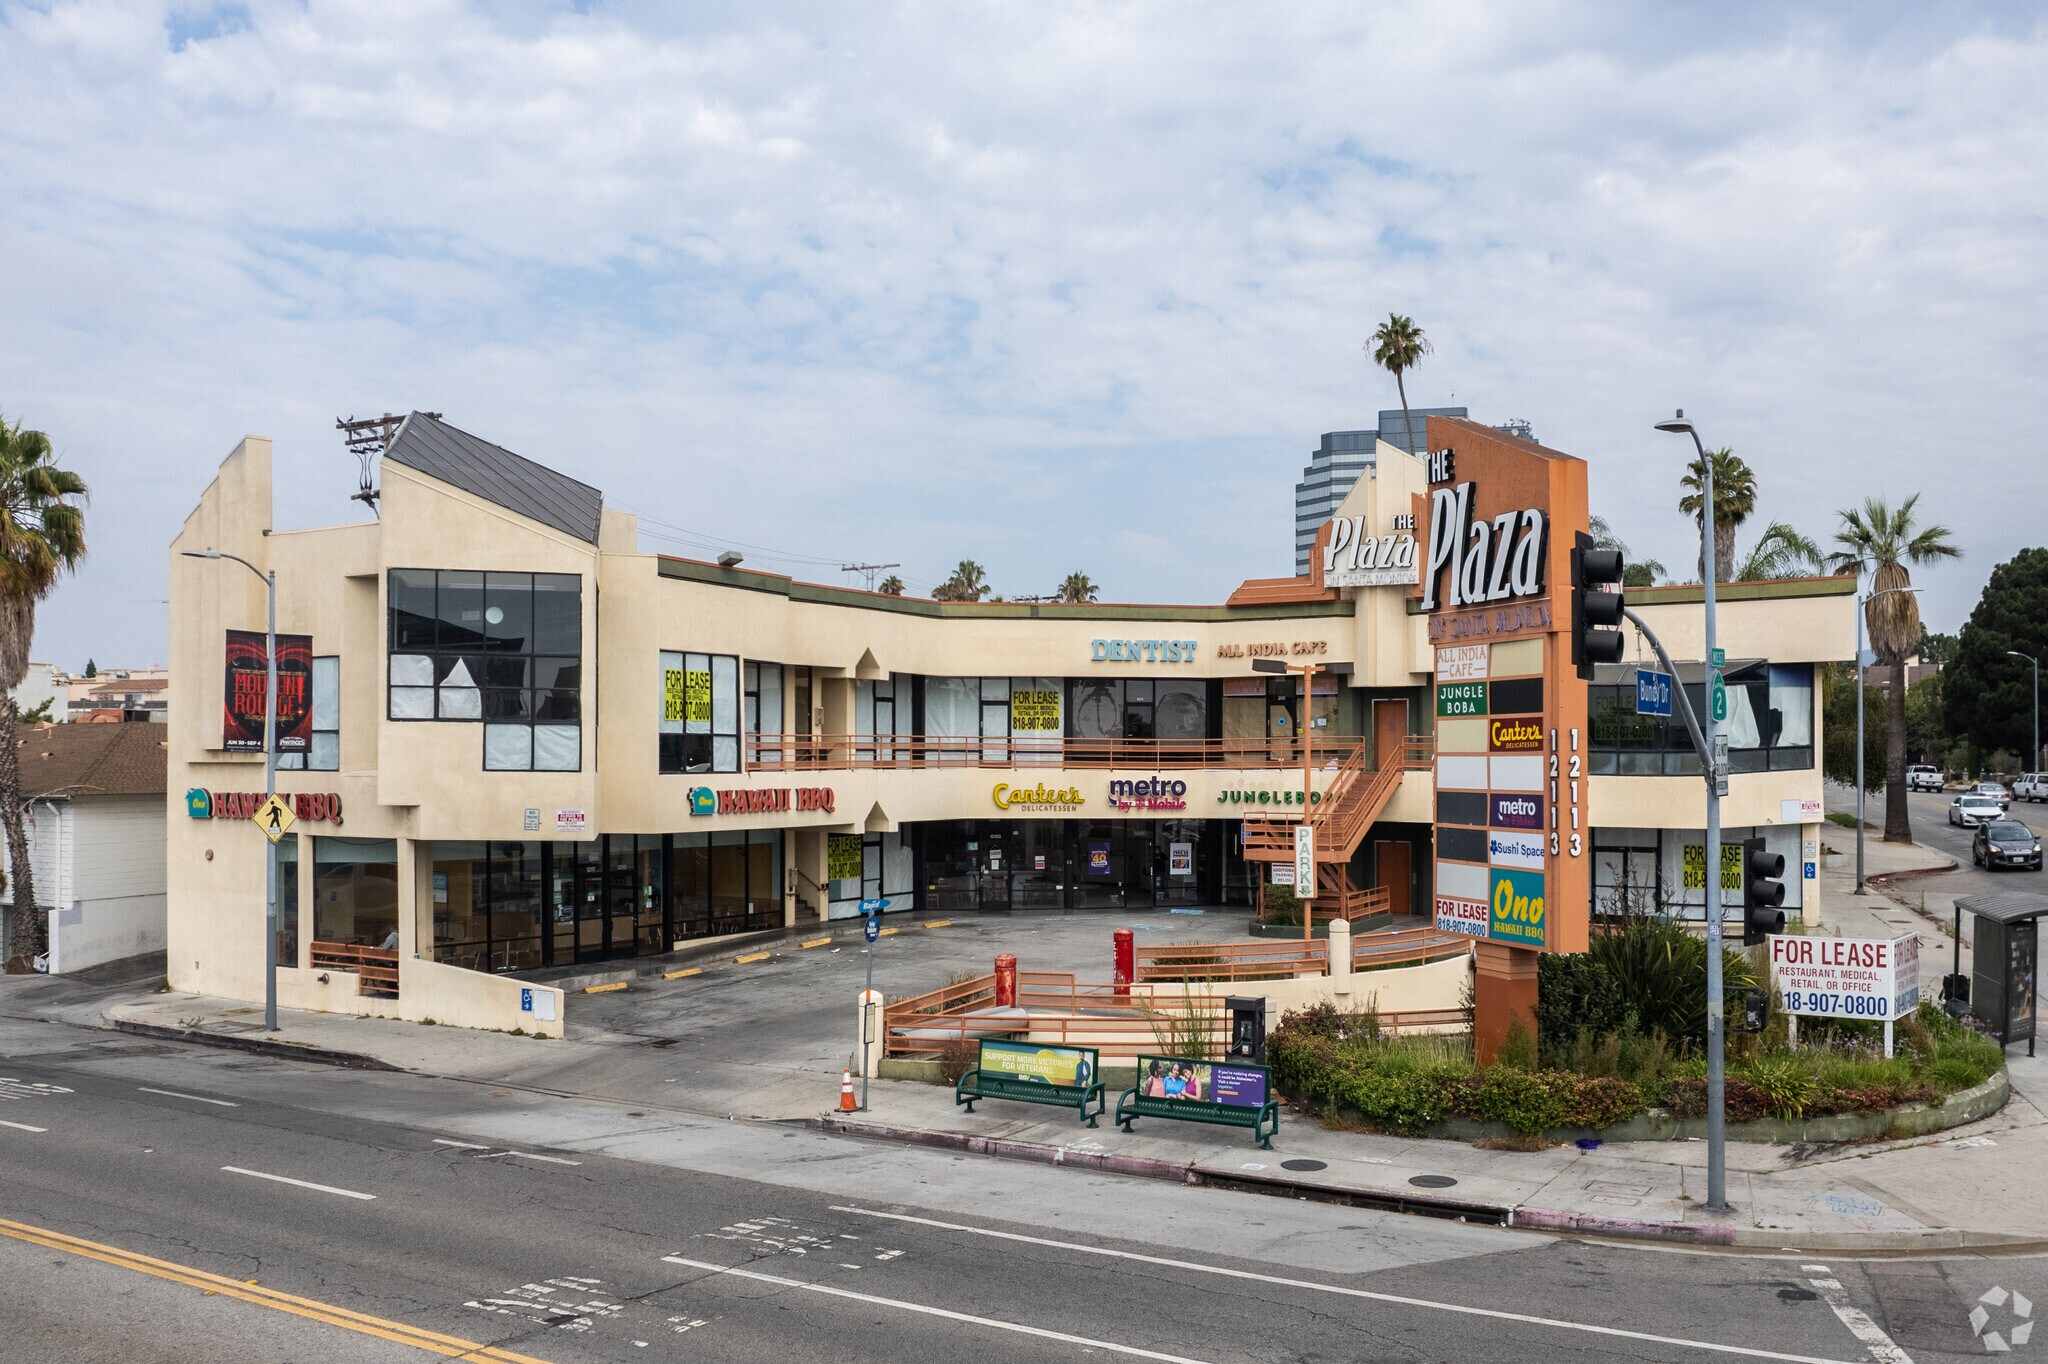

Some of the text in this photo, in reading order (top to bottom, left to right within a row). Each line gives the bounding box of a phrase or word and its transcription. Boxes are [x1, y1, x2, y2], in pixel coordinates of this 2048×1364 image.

[1424, 449, 1453, 484] THE
[1391, 514, 1414, 529] THE
[1323, 515, 1415, 571] Plaza
[1421, 481, 1547, 610] Plaza
[1091, 639, 1198, 662] DENTIST
[1217, 640, 1328, 658] ALL INDIA CAFE
[1438, 646, 1486, 663] ALL INDIA
[666, 670, 681, 688] FOR
[1449, 663, 1474, 677] CAFE
[1013, 692, 1058, 704] FOR LEASE
[1440, 686, 1483, 699] JUNGLE
[1661, 683, 1669, 703] Dr
[1447, 702, 1475, 714] BOBA
[1716, 692, 1723, 714] 2
[1013, 717, 1059, 730] 818-907-0800
[1492, 721, 1542, 746] Canter's
[993, 783, 1086, 809] Canter's
[1109, 776, 1187, 798] metro
[717, 789, 791, 815] HAWAII
[796, 787, 835, 813] BBQ
[1117, 799, 1131, 813] by
[1217, 790, 1343, 804] JUNGLEBO
[295, 792, 343, 825] BBQ
[1499, 799, 1536, 816] metro
[1299, 828, 1311, 884] PARK
[1497, 842, 1544, 858] Sushi Space
[1684, 846, 1741, 862] FOR ASE
[1684, 871, 1741, 889] 818-90800
[863, 901, 880, 909] Rapid
[1437, 900, 1487, 921] FOR LEASE
[1494, 879, 1544, 924] Ono
[1437, 918, 1486, 937] 818-907-0800
[1494, 921, 1544, 941] HAWAII BBQ
[1773, 940, 1887, 968] FOR LEASE
[1840, 970, 1882, 982] MEDICAL,
[1790, 979, 1872, 992] RETAIL, OR OFFICE
[984, 1051, 1074, 1069] SUPPORT MORE VICTORIES
[1002, 1062, 1055, 1075] FOR VETERANS.
